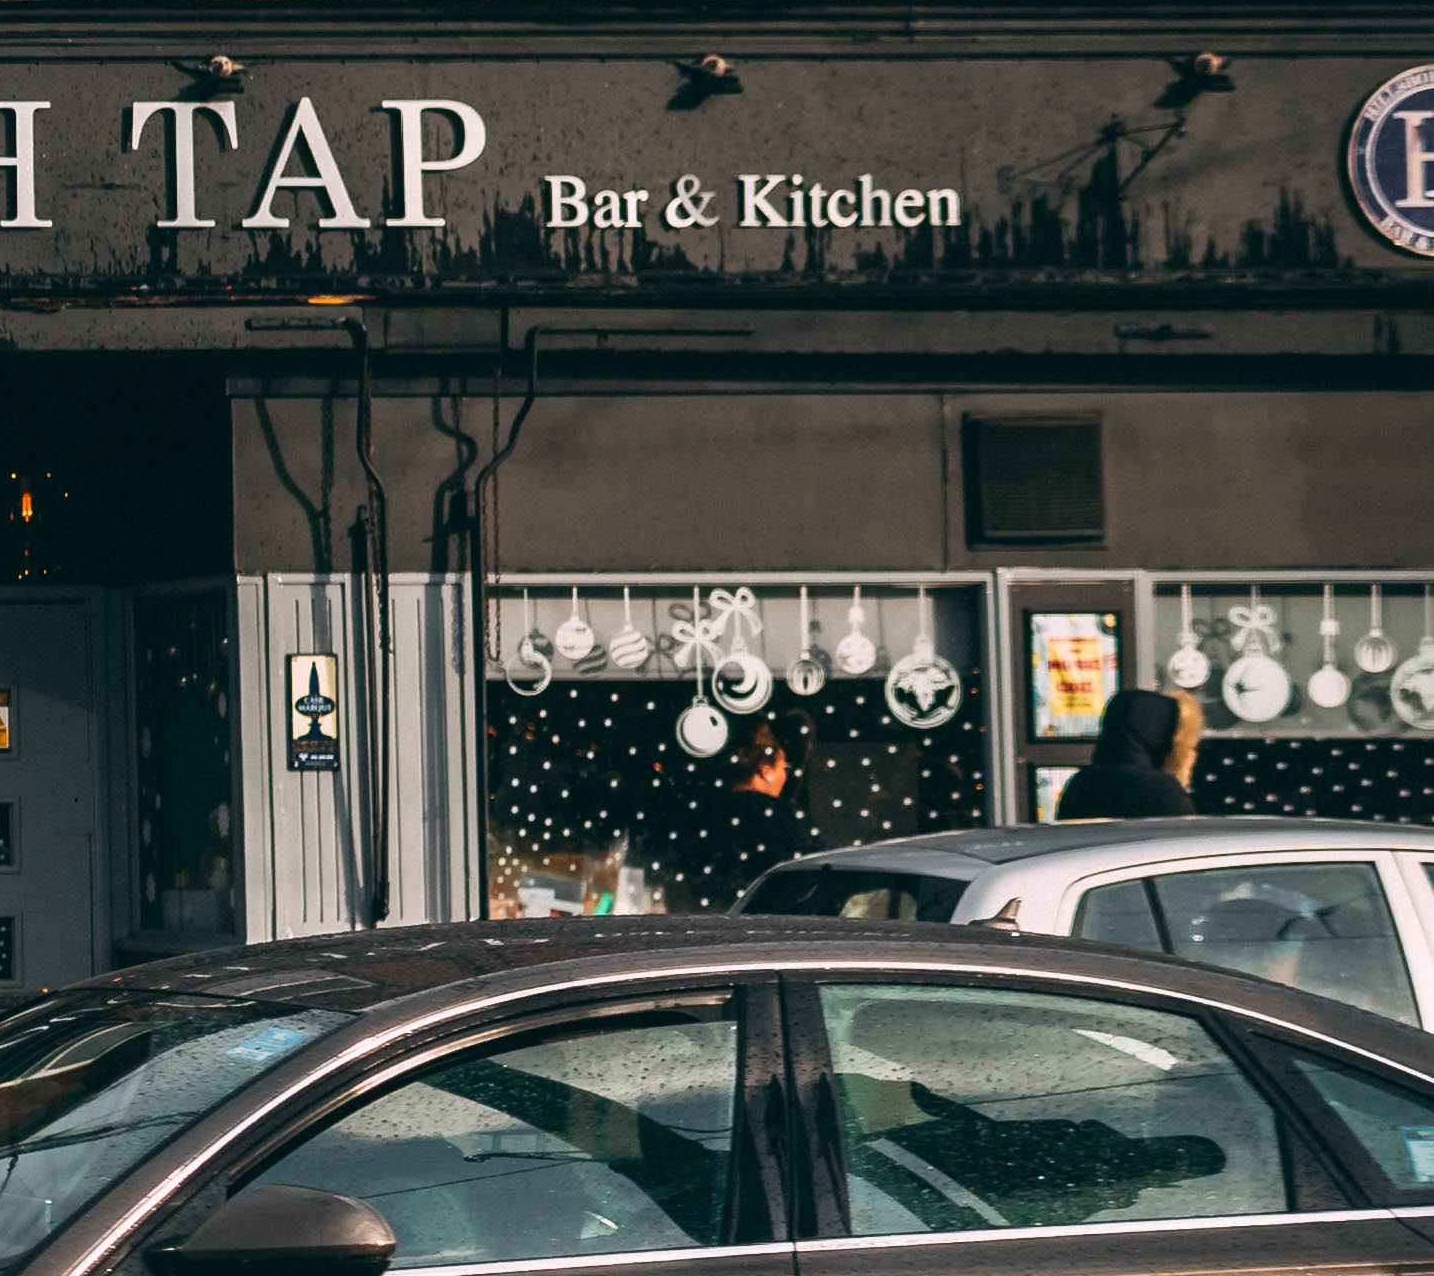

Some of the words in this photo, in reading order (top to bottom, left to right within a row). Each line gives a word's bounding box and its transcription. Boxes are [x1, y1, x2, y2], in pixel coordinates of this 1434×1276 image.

[129, 99, 488, 228] TAP
[546, 175, 648, 228] Bar
[665, 174, 720, 228] &
[740, 174, 962, 227] Kitchen
